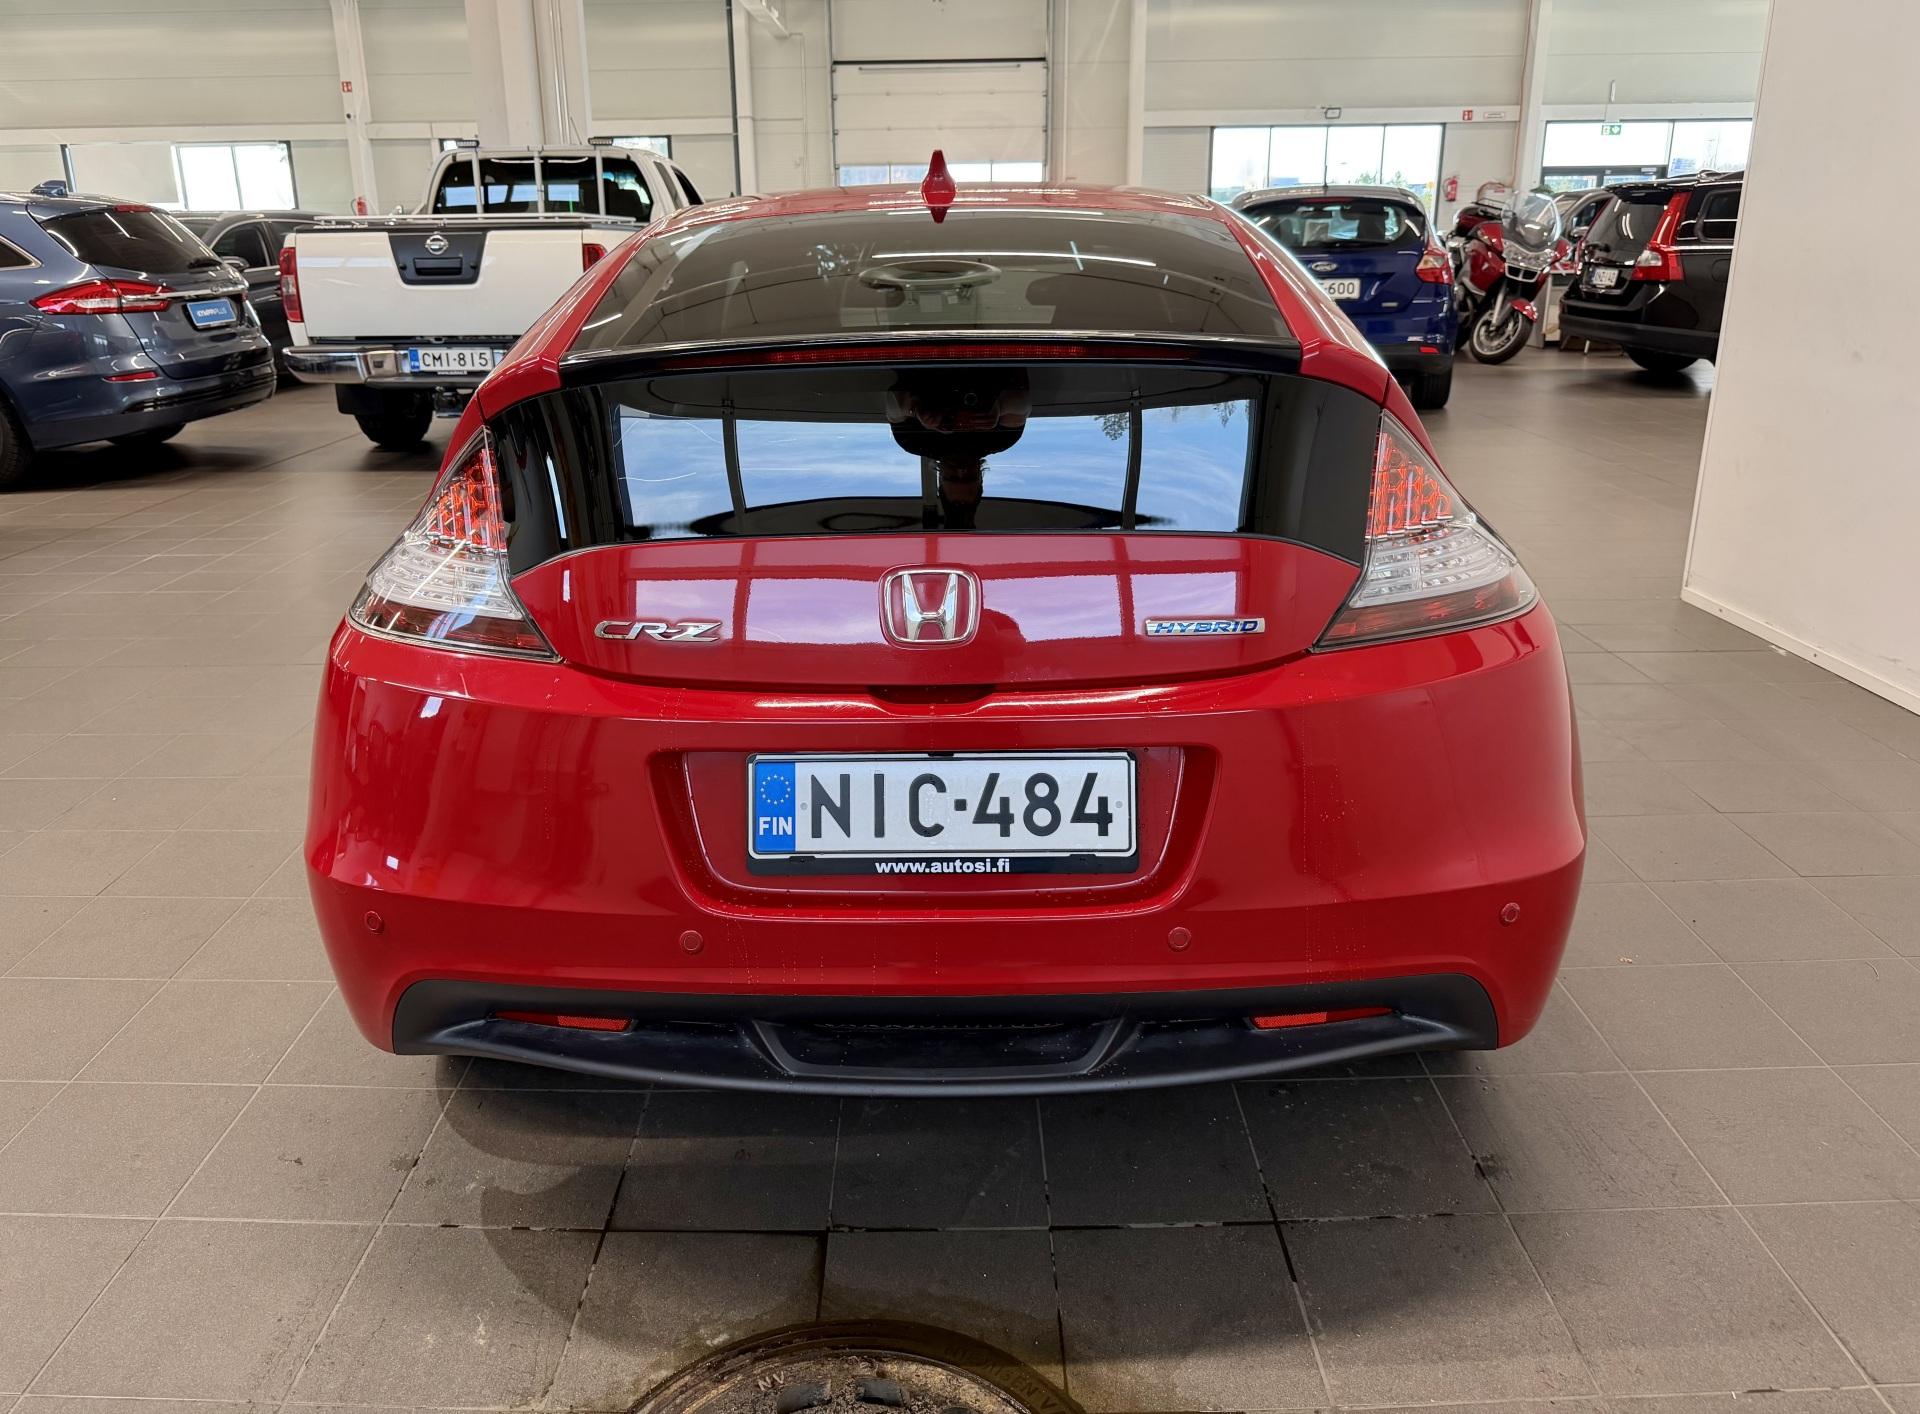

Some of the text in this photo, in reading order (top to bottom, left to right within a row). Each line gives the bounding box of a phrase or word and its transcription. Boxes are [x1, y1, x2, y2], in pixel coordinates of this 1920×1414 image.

[422, 352, 488, 367] CMI-815
[594, 620, 723, 642] CR-Z
[1154, 620, 1258, 634] HYBRID
[810, 772, 1113, 839] NIC-484
[759, 816, 793, 836] FIN
[875, 858, 1011, 874] www.autosi.fi
